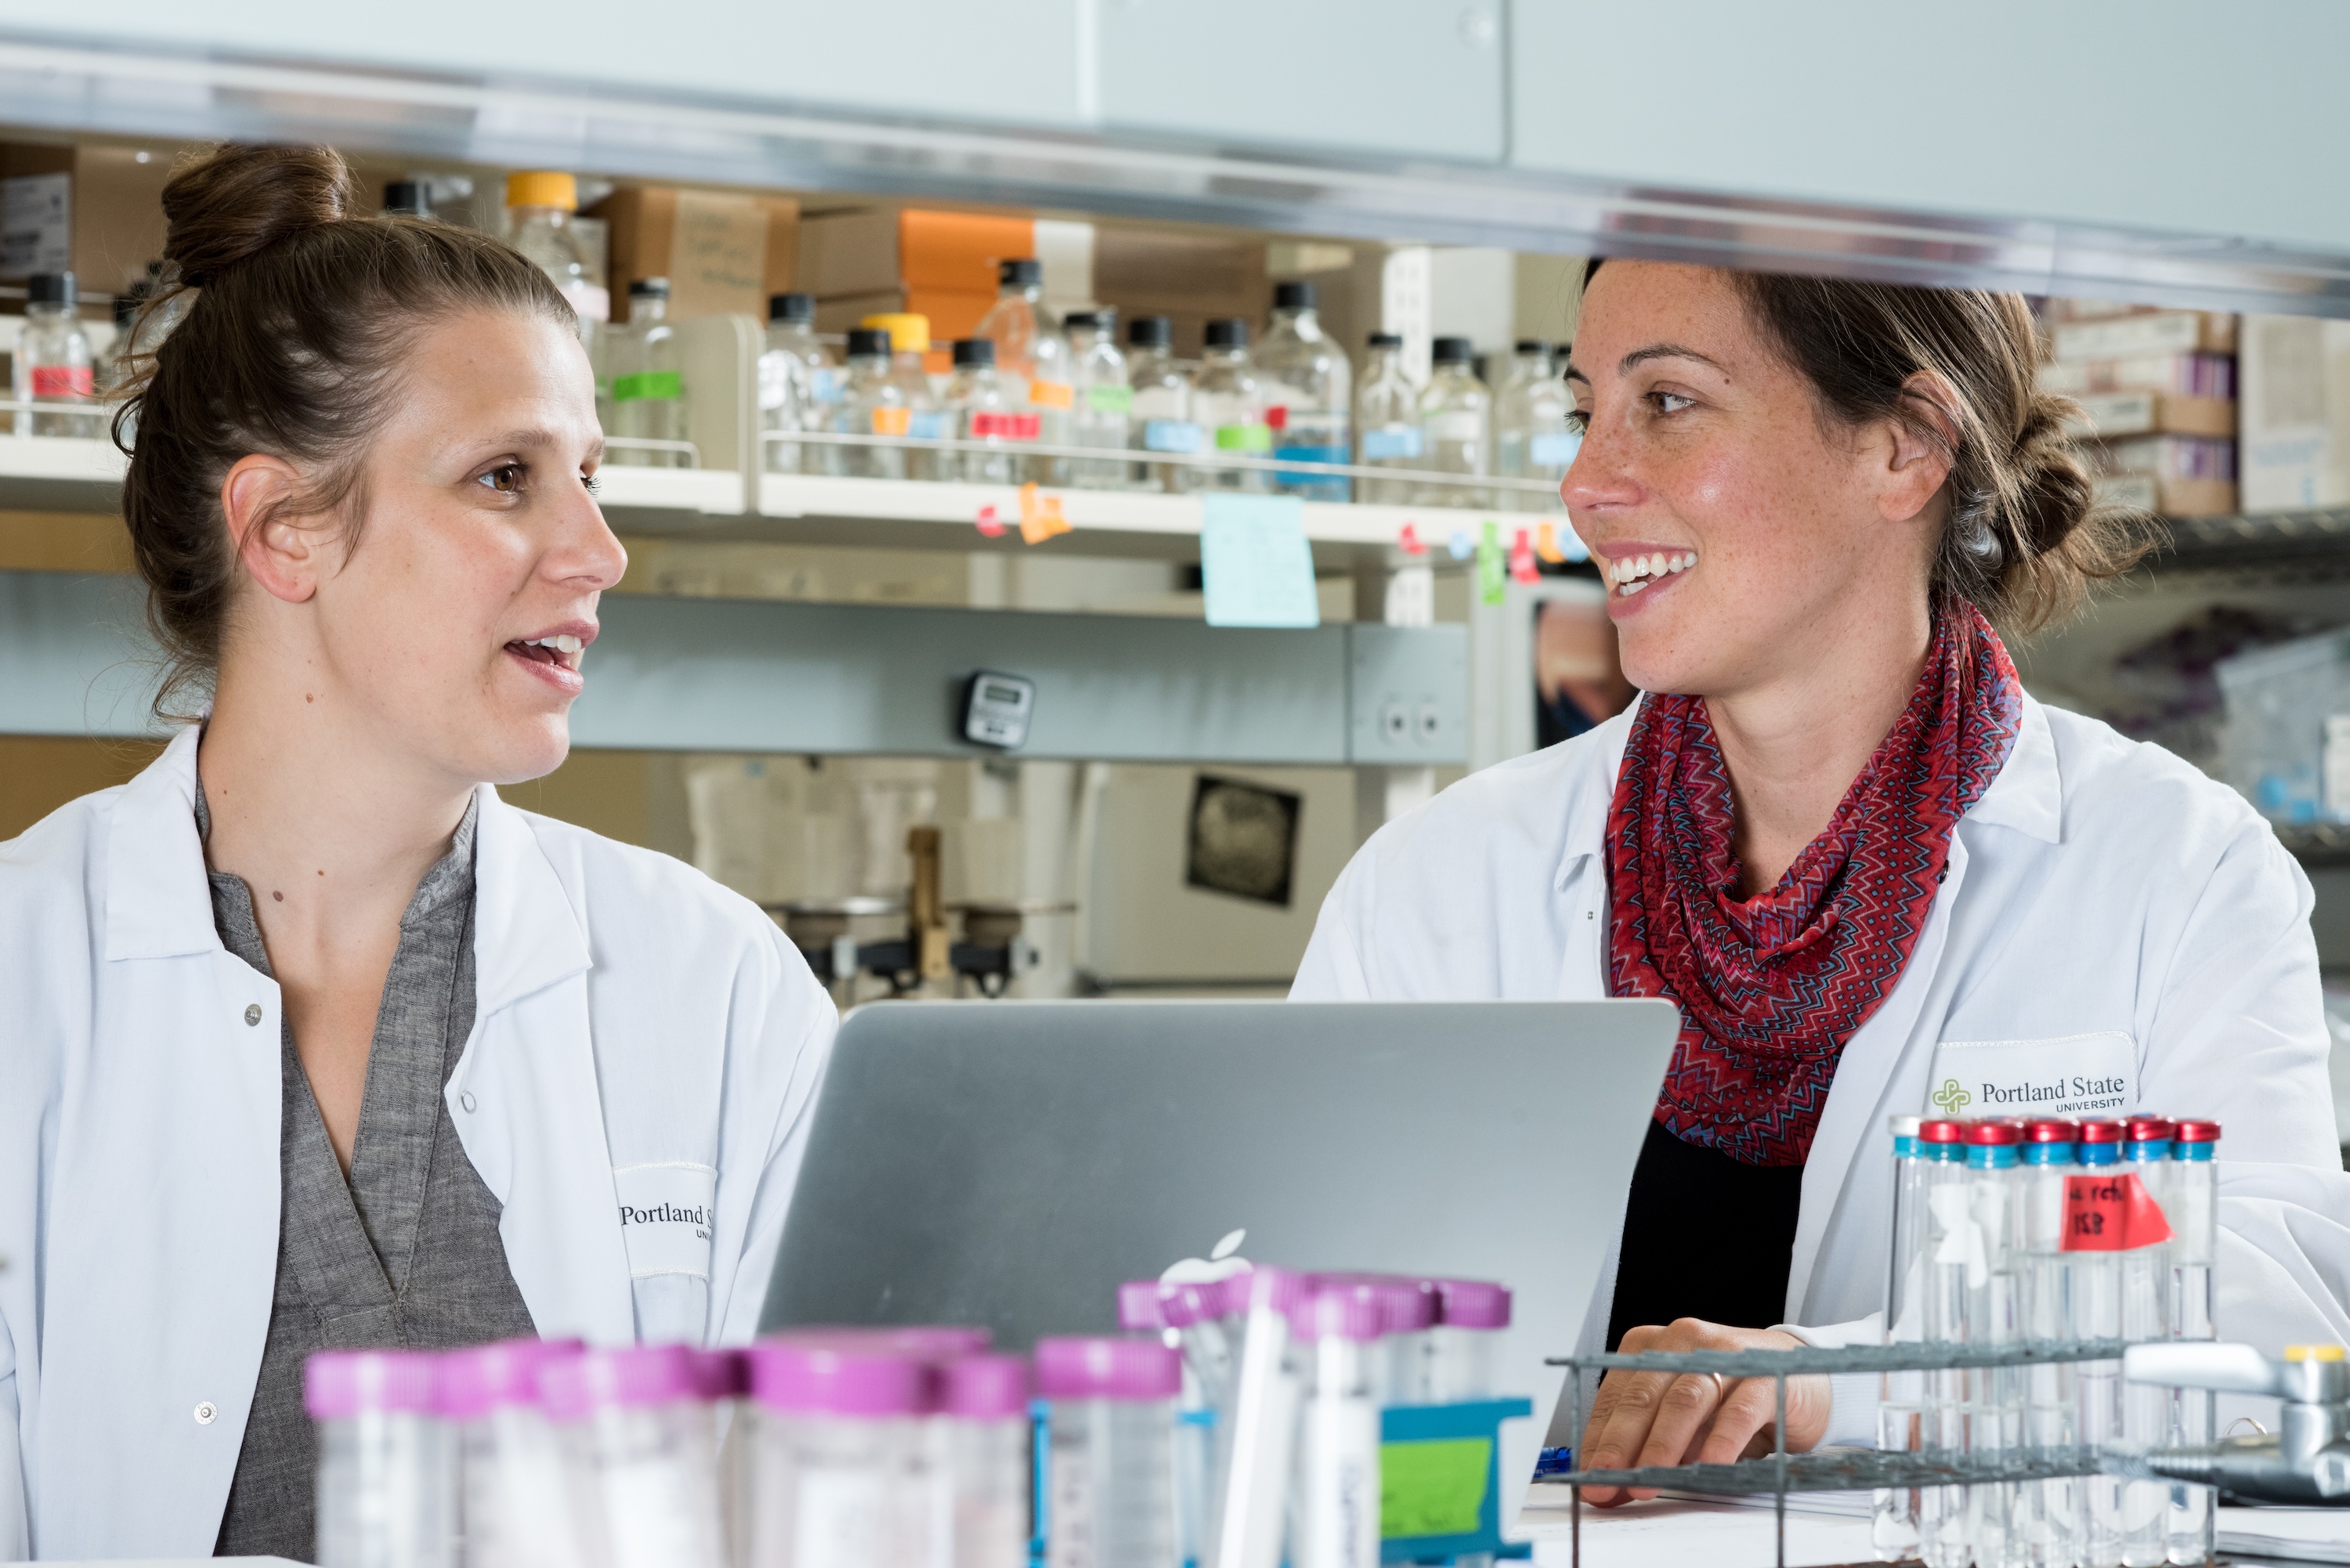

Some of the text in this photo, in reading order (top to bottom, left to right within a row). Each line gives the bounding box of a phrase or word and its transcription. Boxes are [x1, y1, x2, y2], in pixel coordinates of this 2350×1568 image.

[1982, 1077, 2124, 1103] Portland State
[2055, 1097, 2125, 1113] UNIVERSITY
[618, 1202, 712, 1229] Portland S
